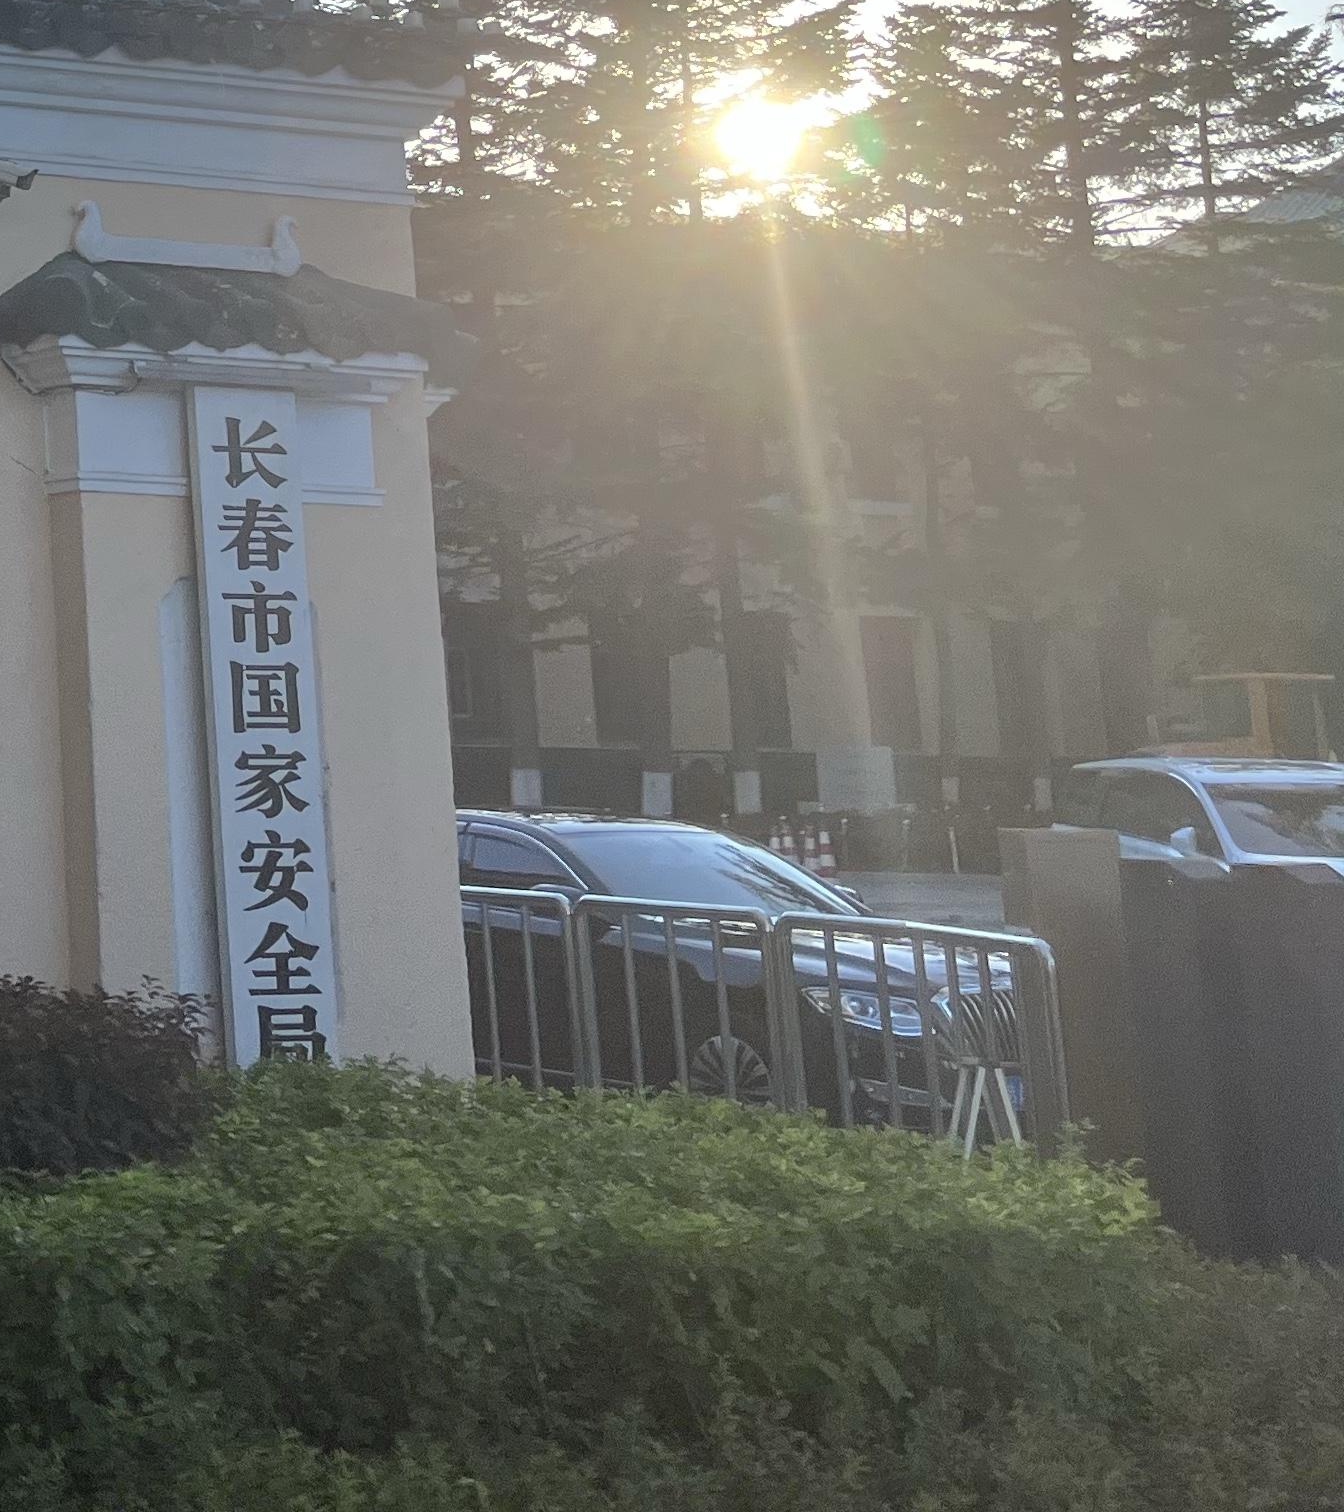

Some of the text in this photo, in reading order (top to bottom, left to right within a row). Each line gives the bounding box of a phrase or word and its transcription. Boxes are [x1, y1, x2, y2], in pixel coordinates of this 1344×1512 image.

[211, 416, 327, 1061] 长春市国家安全局
